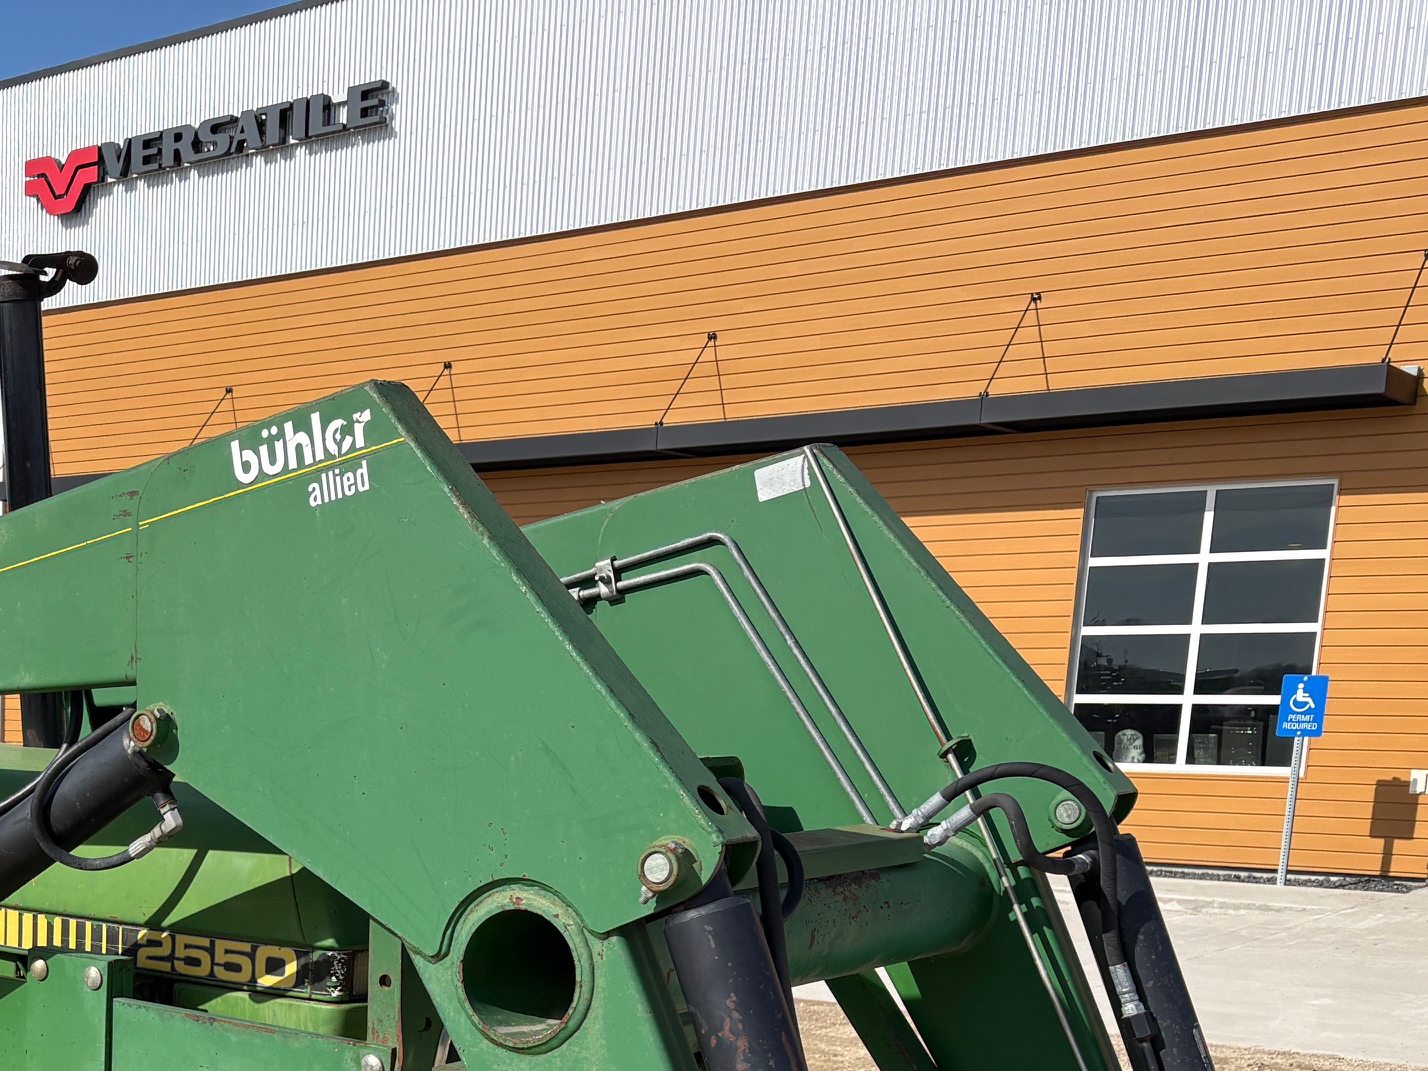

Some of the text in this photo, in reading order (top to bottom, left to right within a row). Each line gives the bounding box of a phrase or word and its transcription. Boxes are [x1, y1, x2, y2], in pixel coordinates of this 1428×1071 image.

[101, 80, 390, 180] VERSATILE
[308, 460, 370, 507] allied
[1282, 721, 1318, 731] REQUIRED
[1287, 714, 1315, 722] PERMIT
[137, 929, 298, 989] 2550
